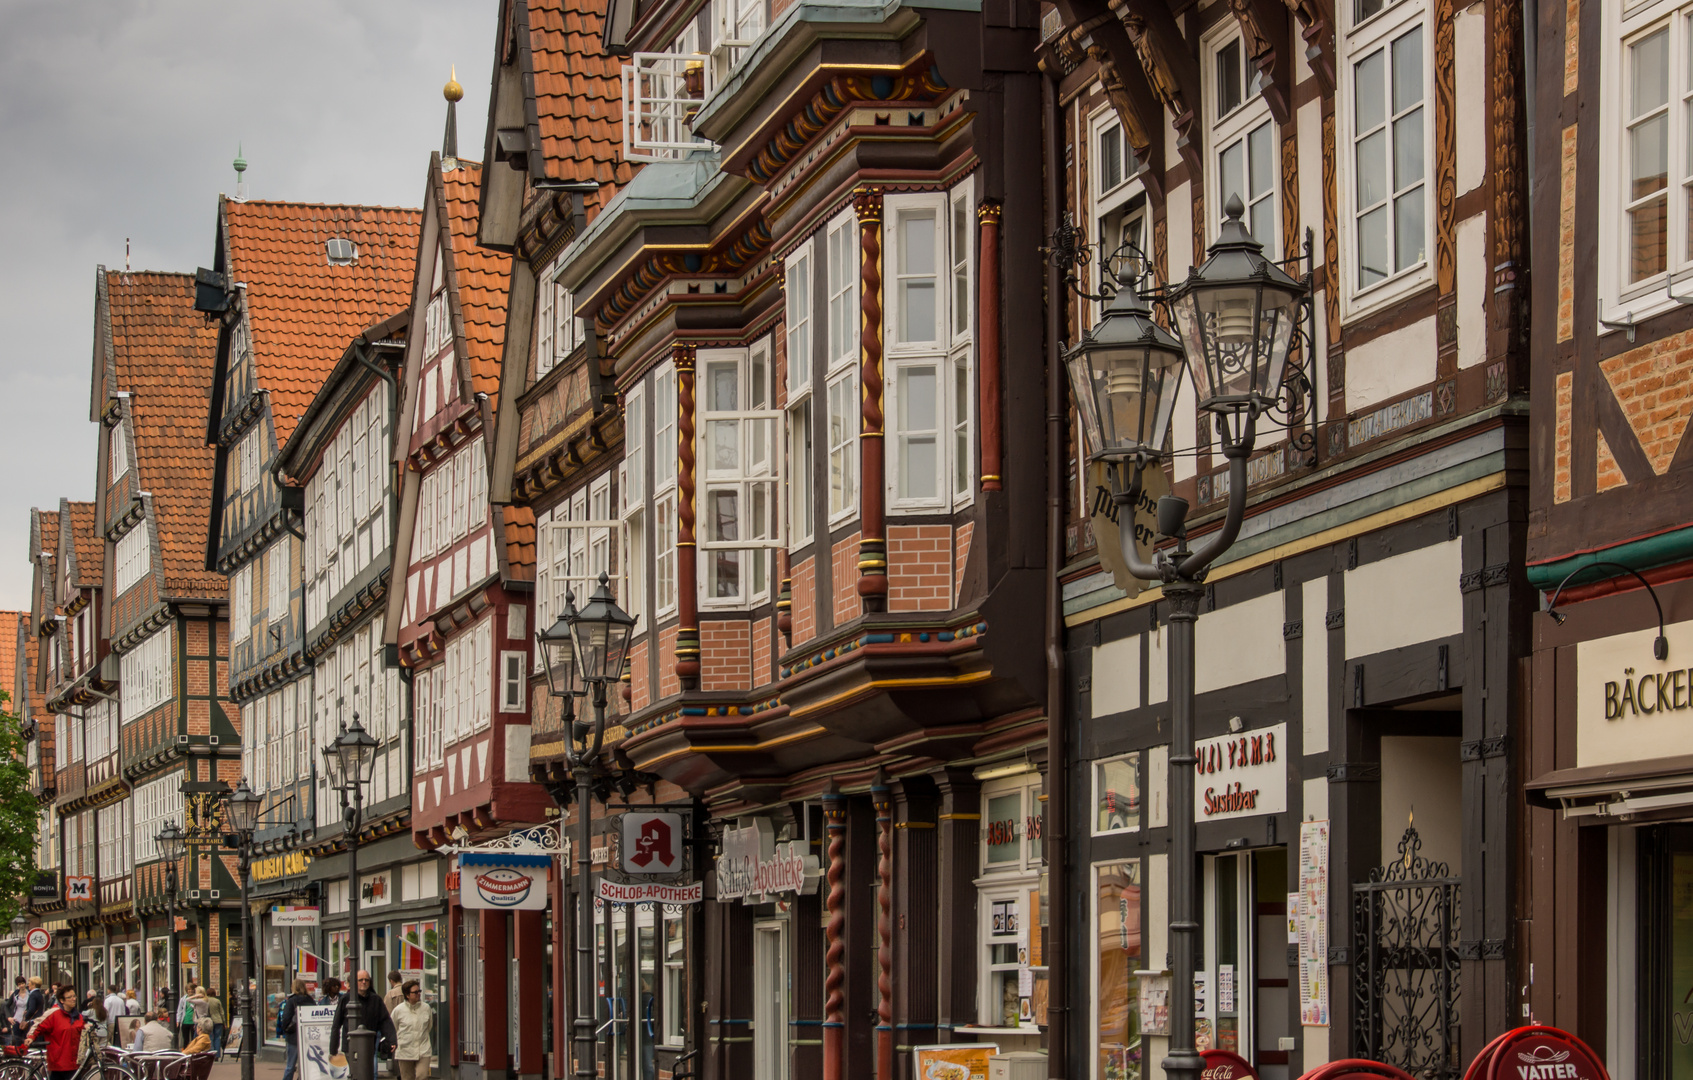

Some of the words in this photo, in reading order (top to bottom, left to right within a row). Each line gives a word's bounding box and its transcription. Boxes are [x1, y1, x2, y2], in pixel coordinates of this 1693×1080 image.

[1138, 489, 1157, 517] hr.
[1605, 667, 1693, 719] BÄCKE
[1196, 743, 1222, 775] UJI
[1227, 732, 1275, 769] YAMA
[1204, 782, 1259, 815] Sushibar
[753, 847, 803, 901] Apotheke
[72, 883, 86, 894] M
[478, 878, 529, 892] ZIMMERMANN
[491, 894, 516, 902] Qualität
[298, 914, 315, 922] family
[311, 1007, 337, 1017] LAVAZ
[1516, 1063, 1579, 1080] VATTER
